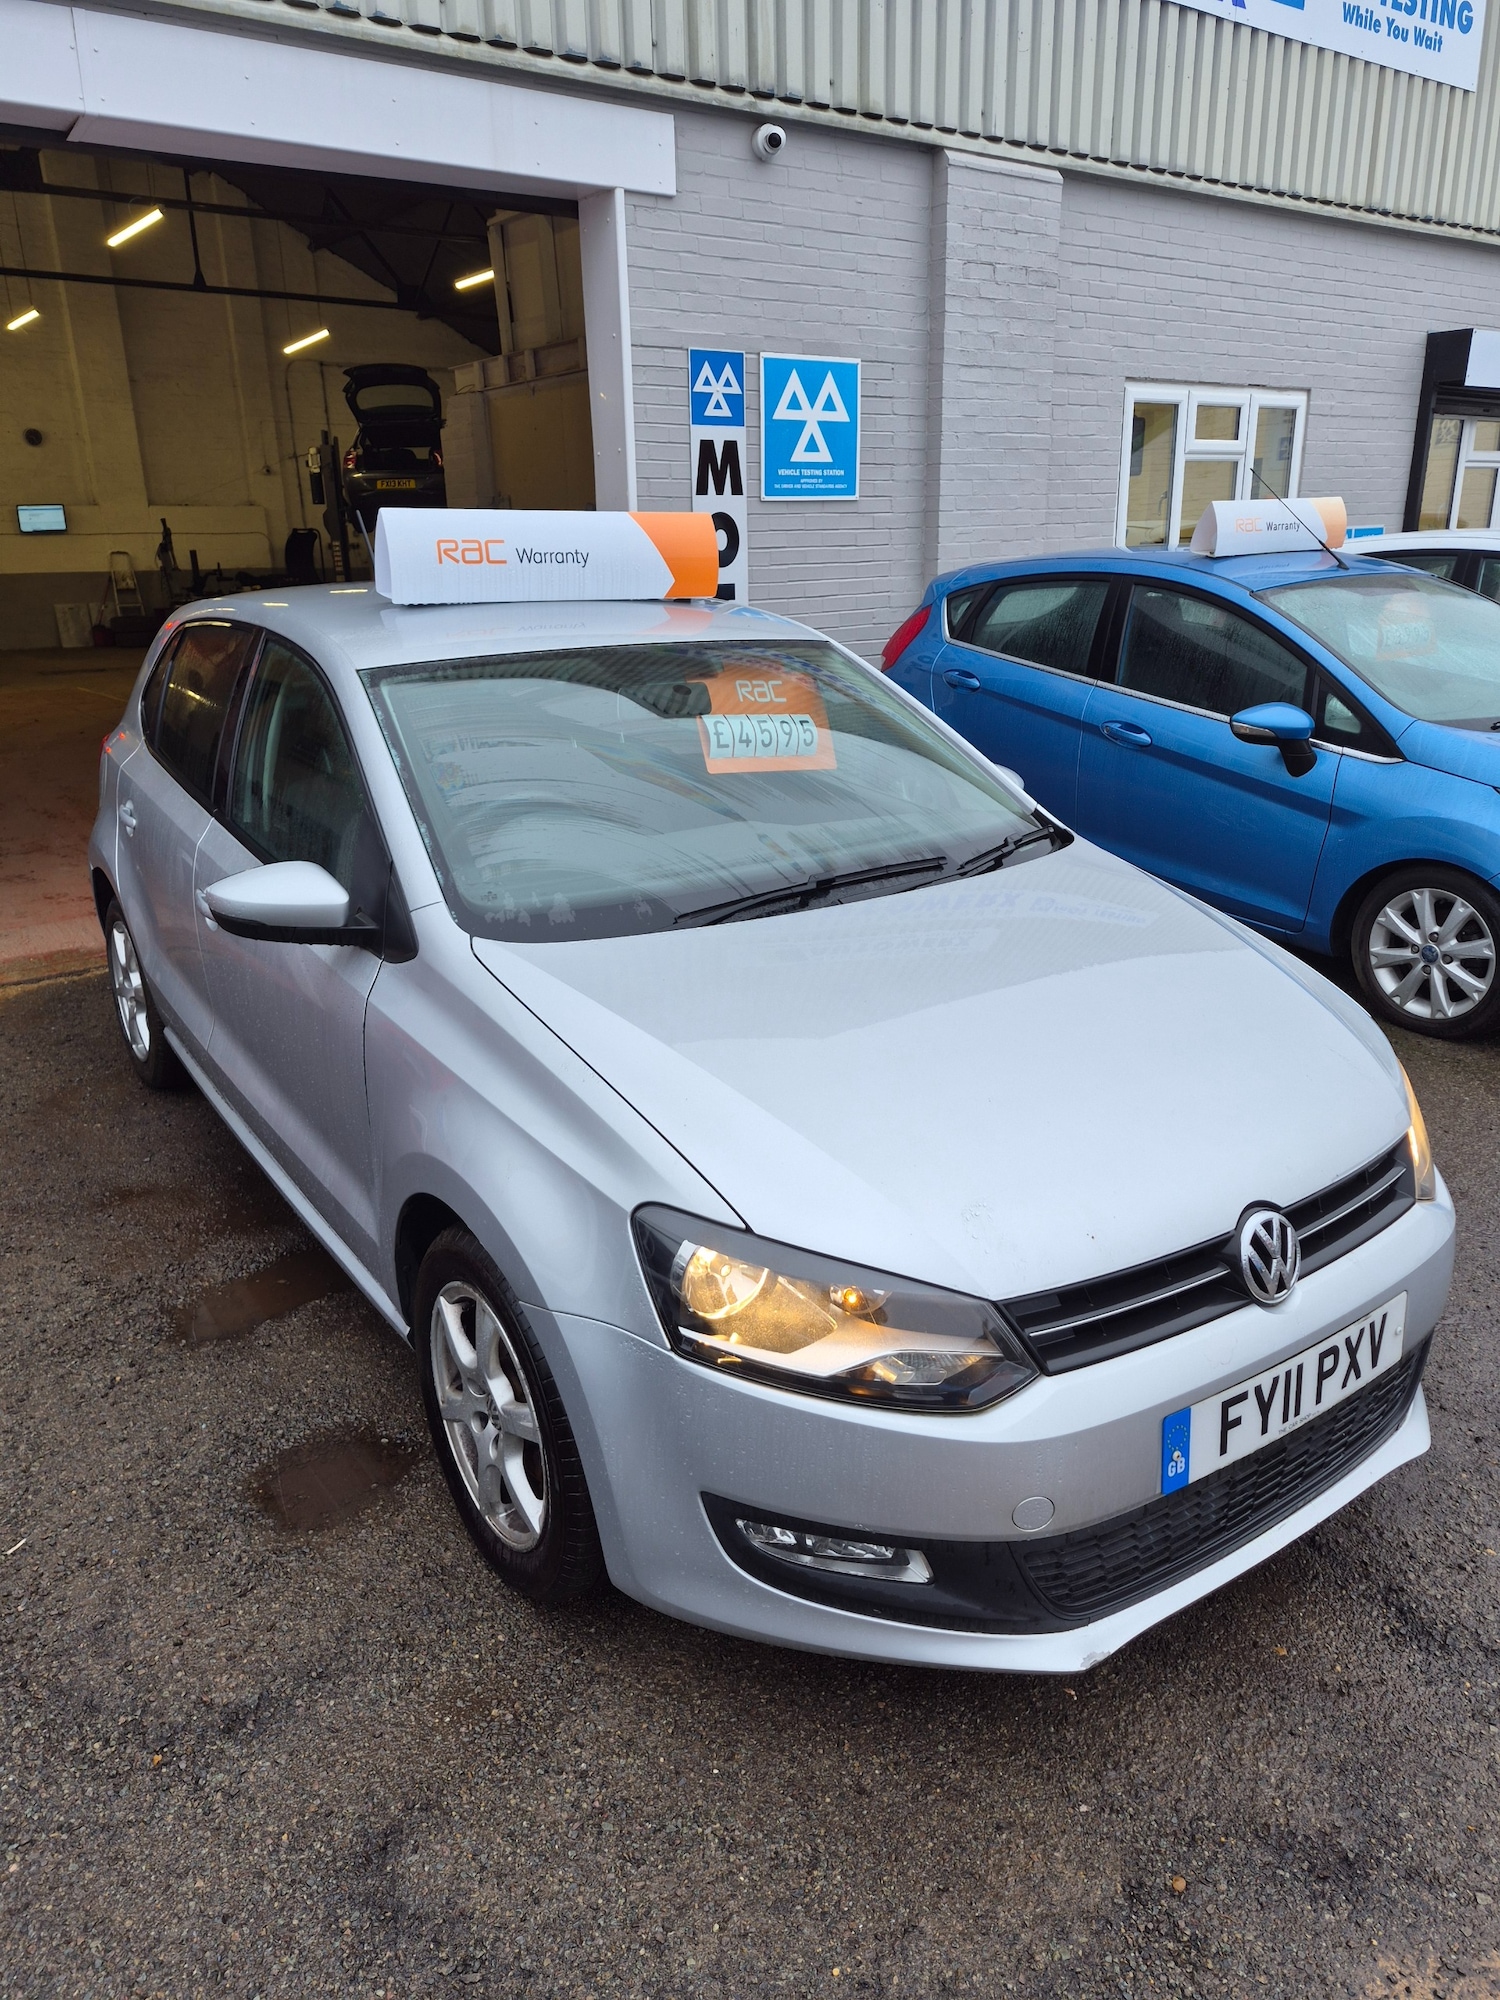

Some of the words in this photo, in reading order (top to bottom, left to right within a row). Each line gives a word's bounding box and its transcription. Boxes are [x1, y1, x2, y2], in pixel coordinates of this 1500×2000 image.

[1342, 2, 1382, 34] While
[1386, 16, 1409, 42] You
[1413, 26, 1443, 53] Wait
[1380, 0, 1473, 34] STING
[777, 468, 801, 476] VEHICLE
[696, 439, 744, 600] MO
[1266, 521, 1300, 532] Warranty
[515, 547, 589, 568] Warranty
[713, 719, 814, 749] £4595
[1219, 1362, 1304, 1457] FY11
[1315, 1311, 1388, 1406] PXV
[1167, 1458, 1186, 1478] GB
